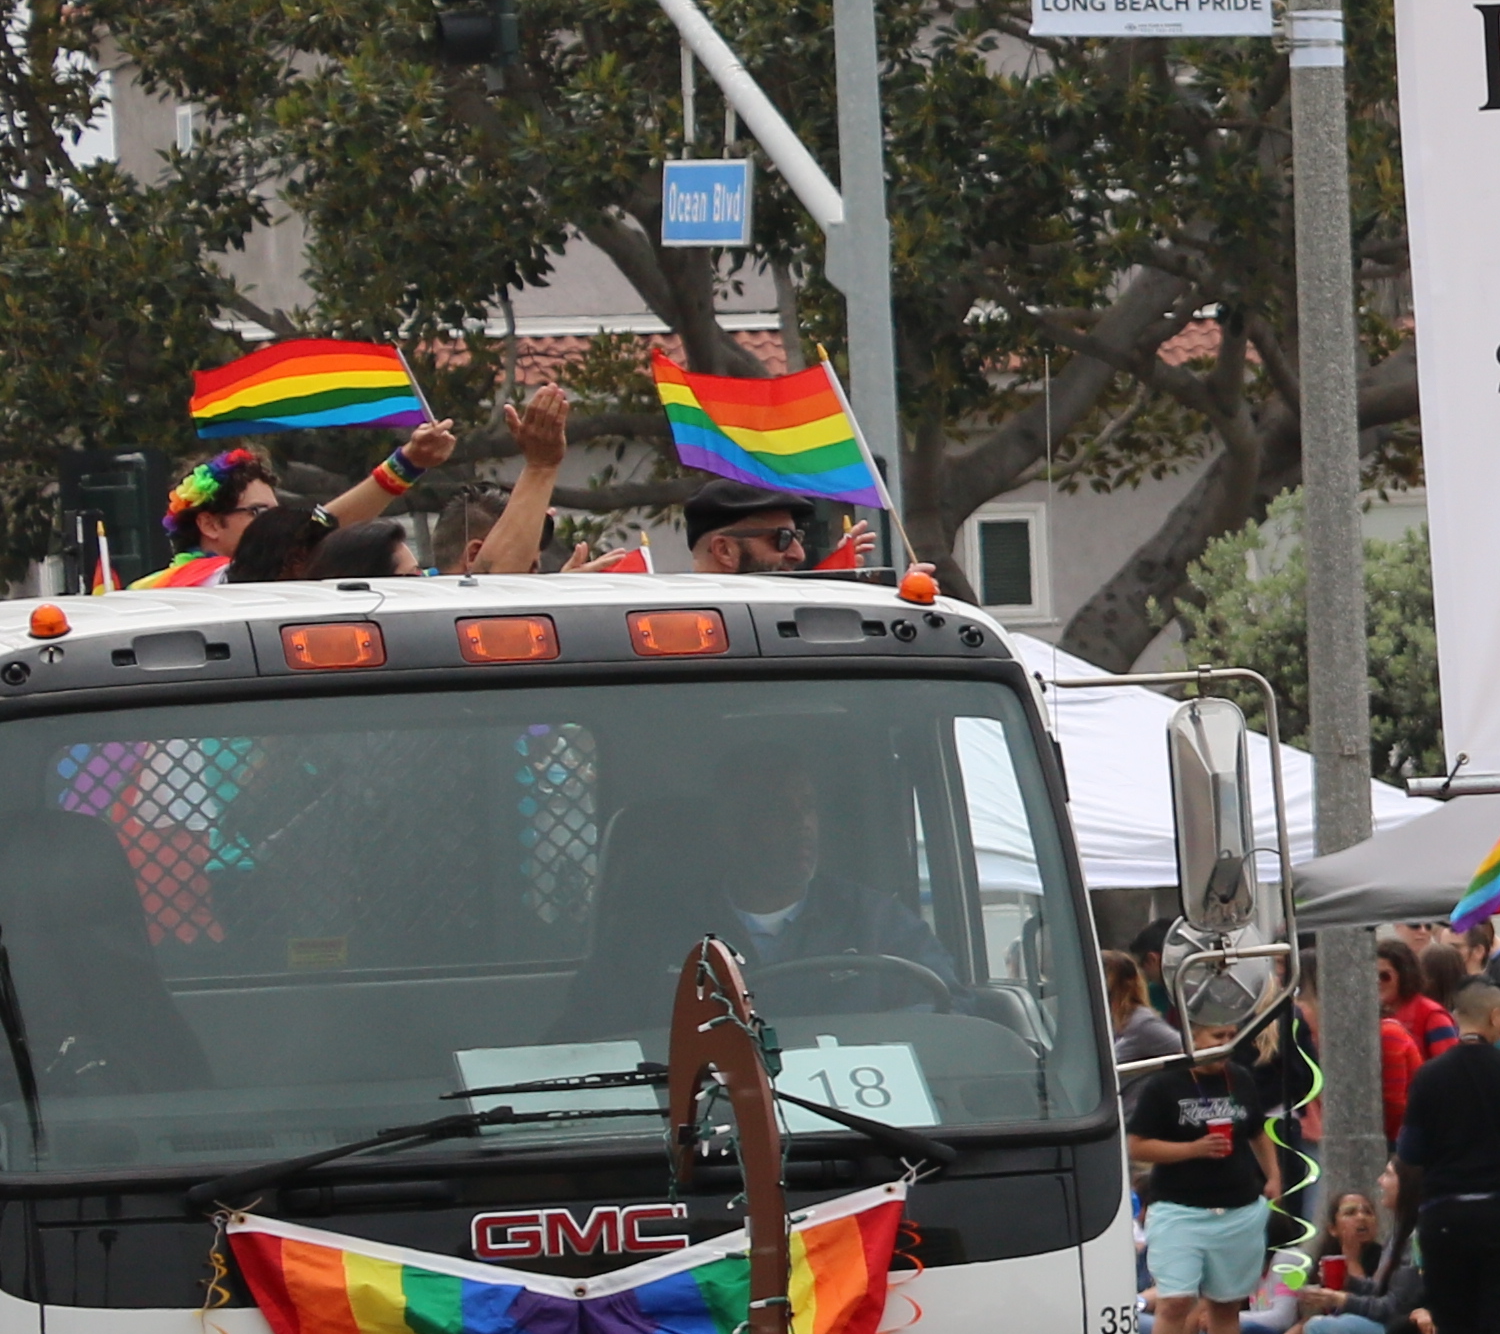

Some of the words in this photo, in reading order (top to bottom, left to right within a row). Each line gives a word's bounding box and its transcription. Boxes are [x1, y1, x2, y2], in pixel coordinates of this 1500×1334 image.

[669, 182, 708, 222] Ocean
[713, 182, 741, 222] Blvd
[808, 1066, 890, 1110] 18
[471, 1203, 688, 1259] GMC
